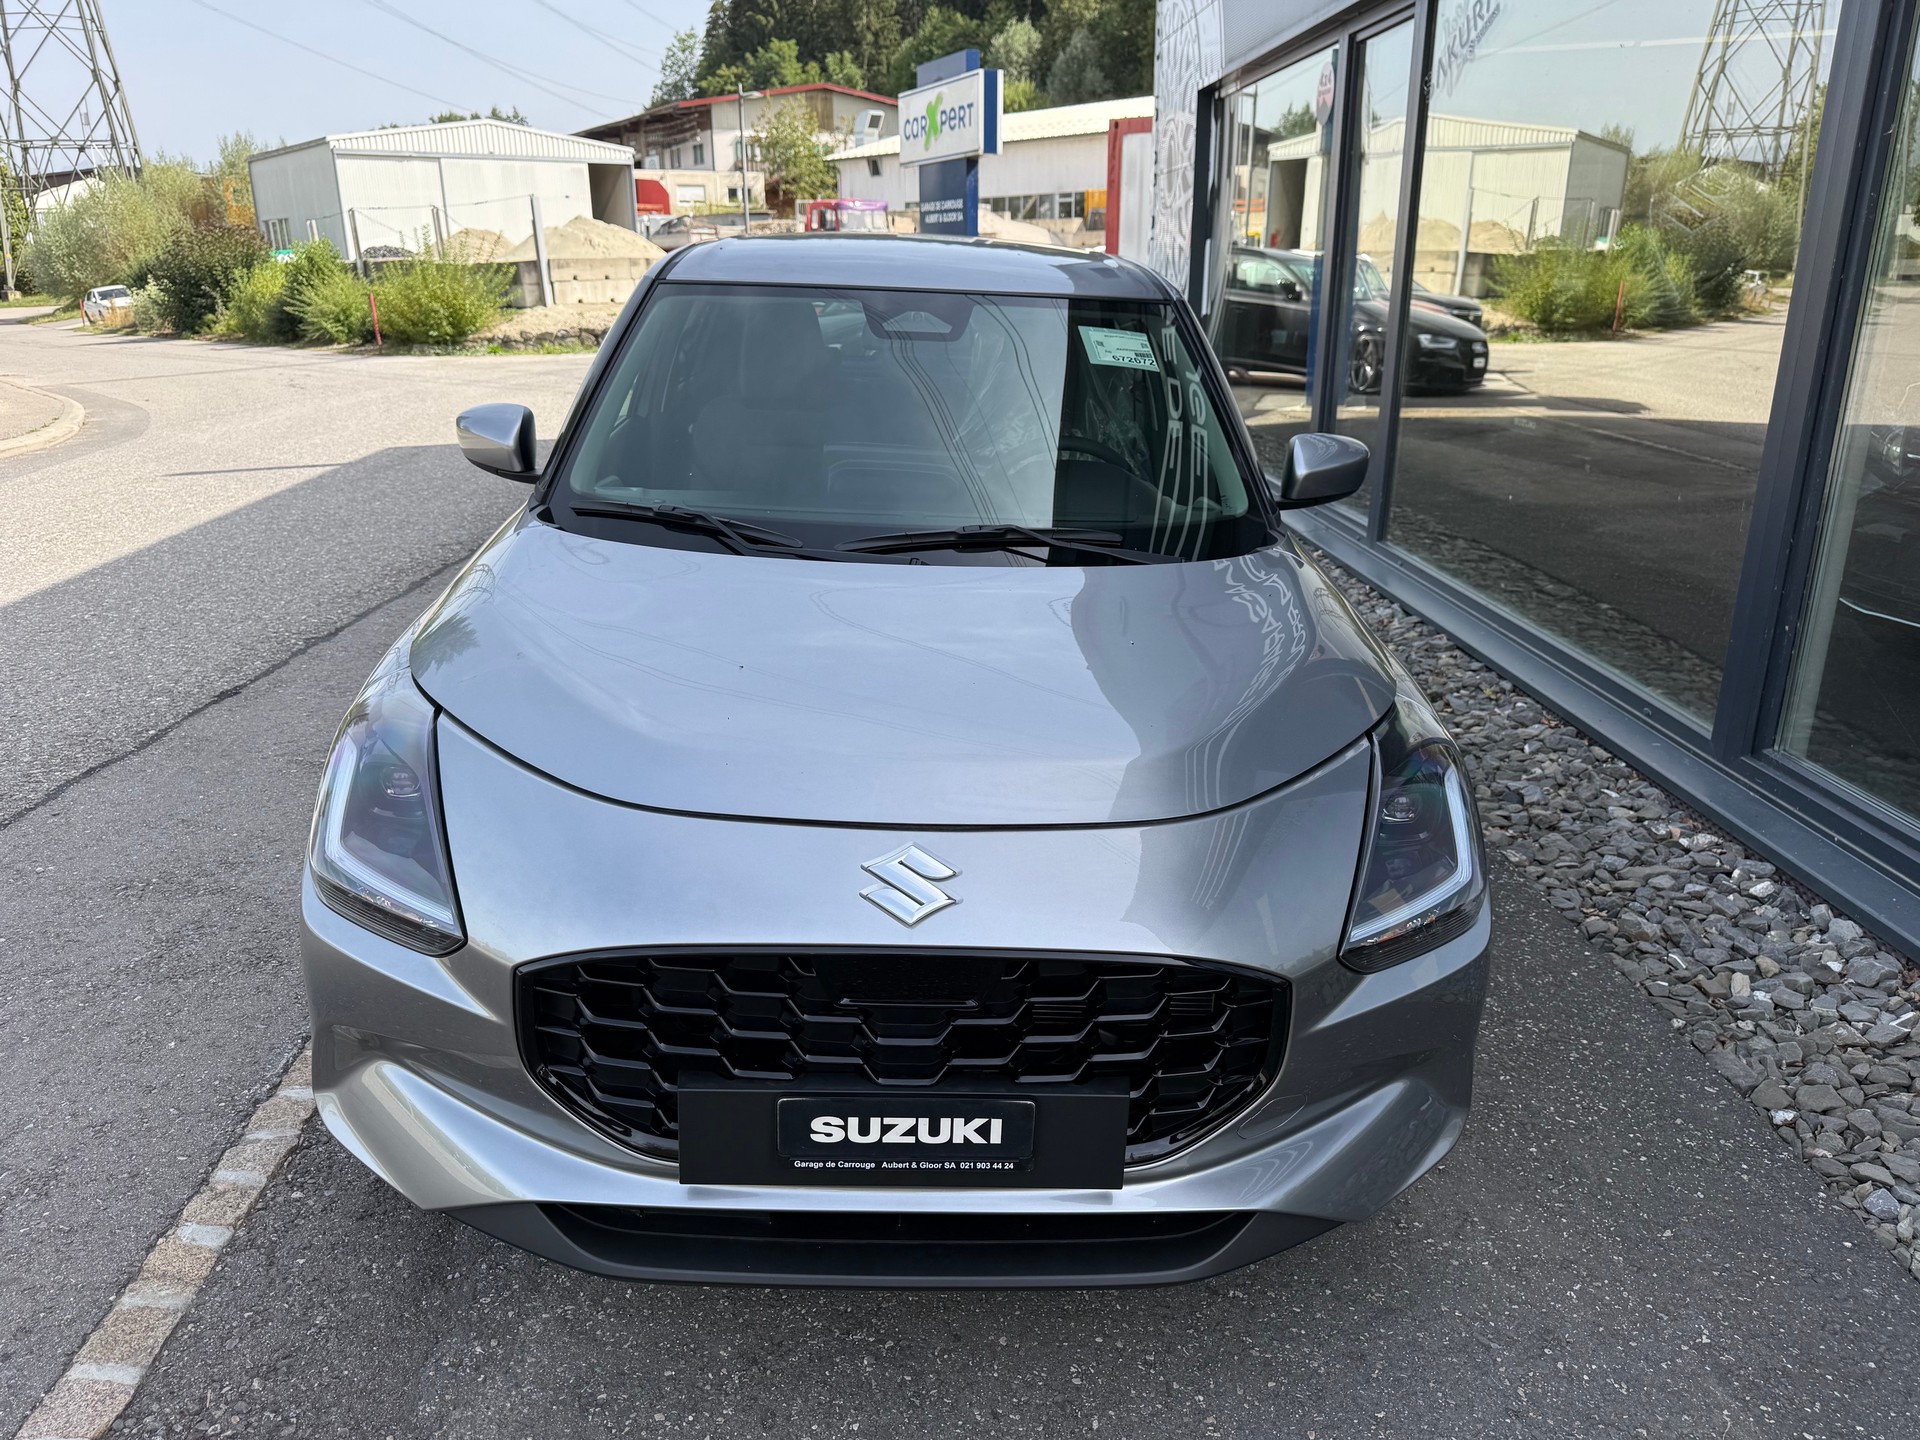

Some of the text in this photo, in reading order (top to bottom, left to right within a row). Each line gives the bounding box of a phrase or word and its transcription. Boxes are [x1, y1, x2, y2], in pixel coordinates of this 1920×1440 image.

[809, 1115, 1003, 1145] SUZUKI
[794, 1160, 1014, 1170] Garage de Carrouge Aubert & Gloor SA 021 903 44 24
